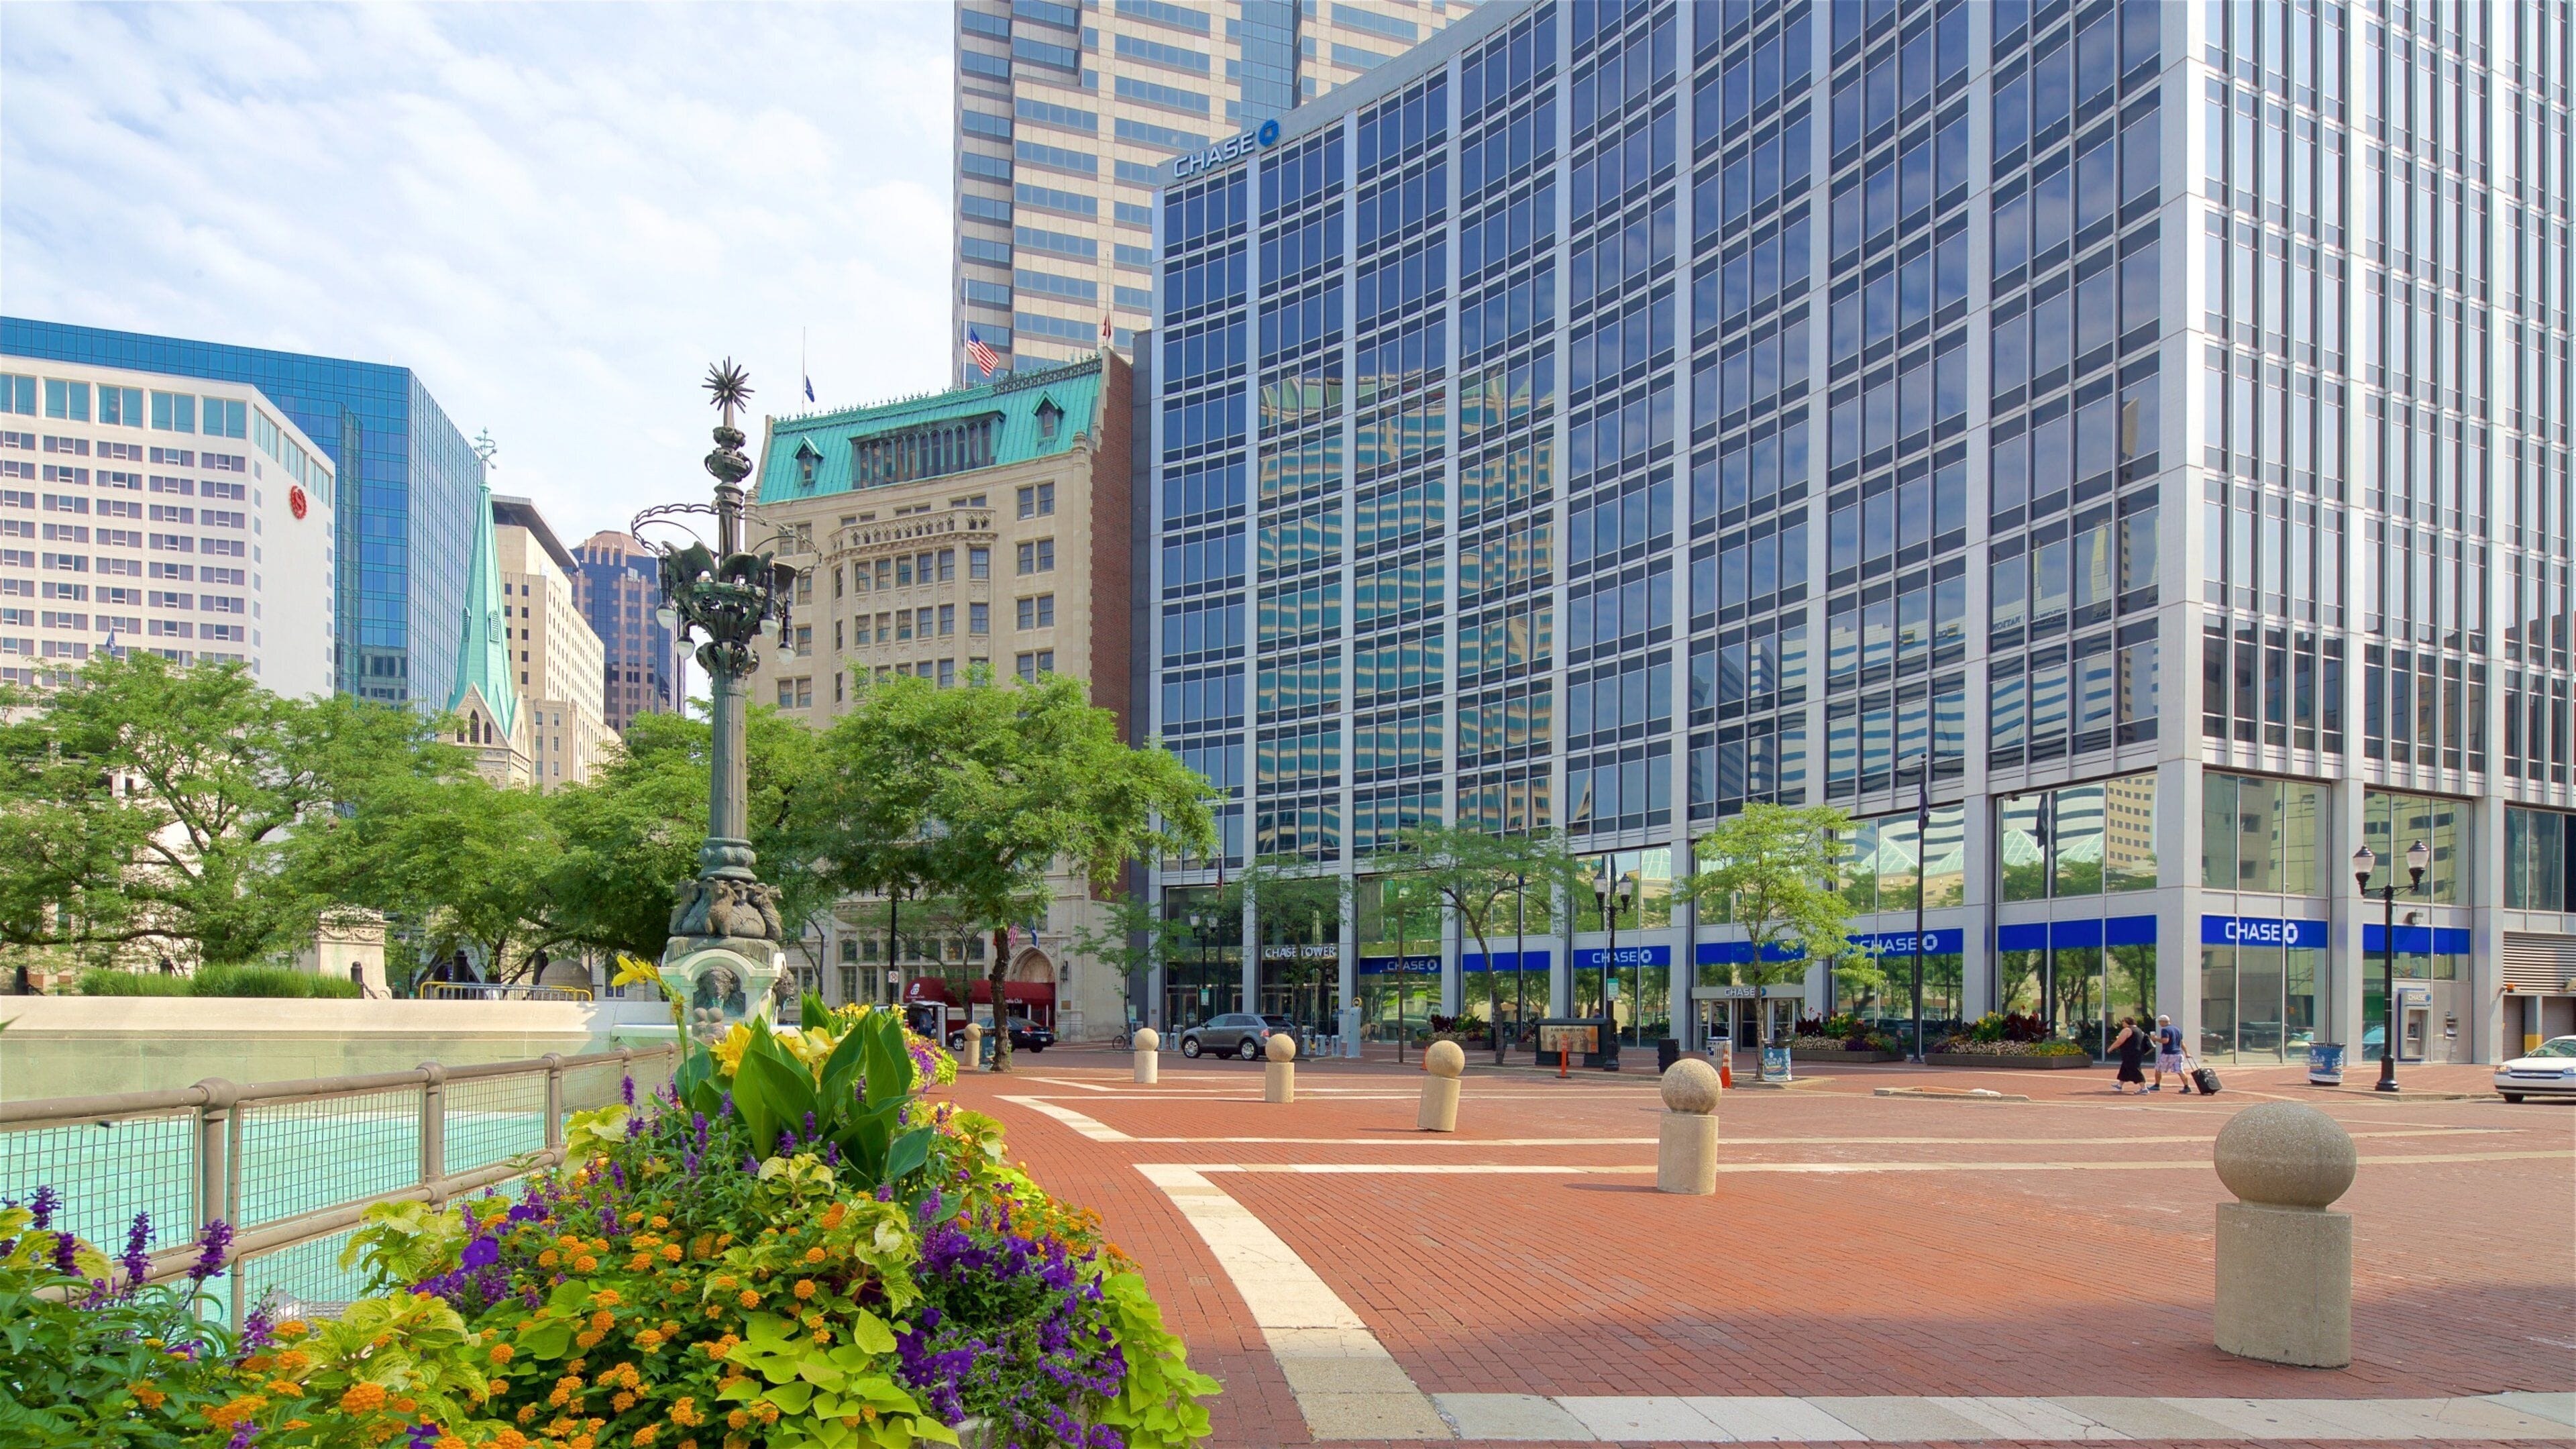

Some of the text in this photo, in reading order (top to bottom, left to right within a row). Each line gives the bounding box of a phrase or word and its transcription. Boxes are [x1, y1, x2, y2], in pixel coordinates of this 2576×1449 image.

[1173, 131, 1255, 178] CHASE
[2225, 922, 2281, 941] CHASE
[1860, 938, 1917, 952] CHASE
[1265, 947, 1297, 957] CHASE
[1593, 951, 1637, 963] CHASE
[1725, 987, 1756, 996] CHASE
